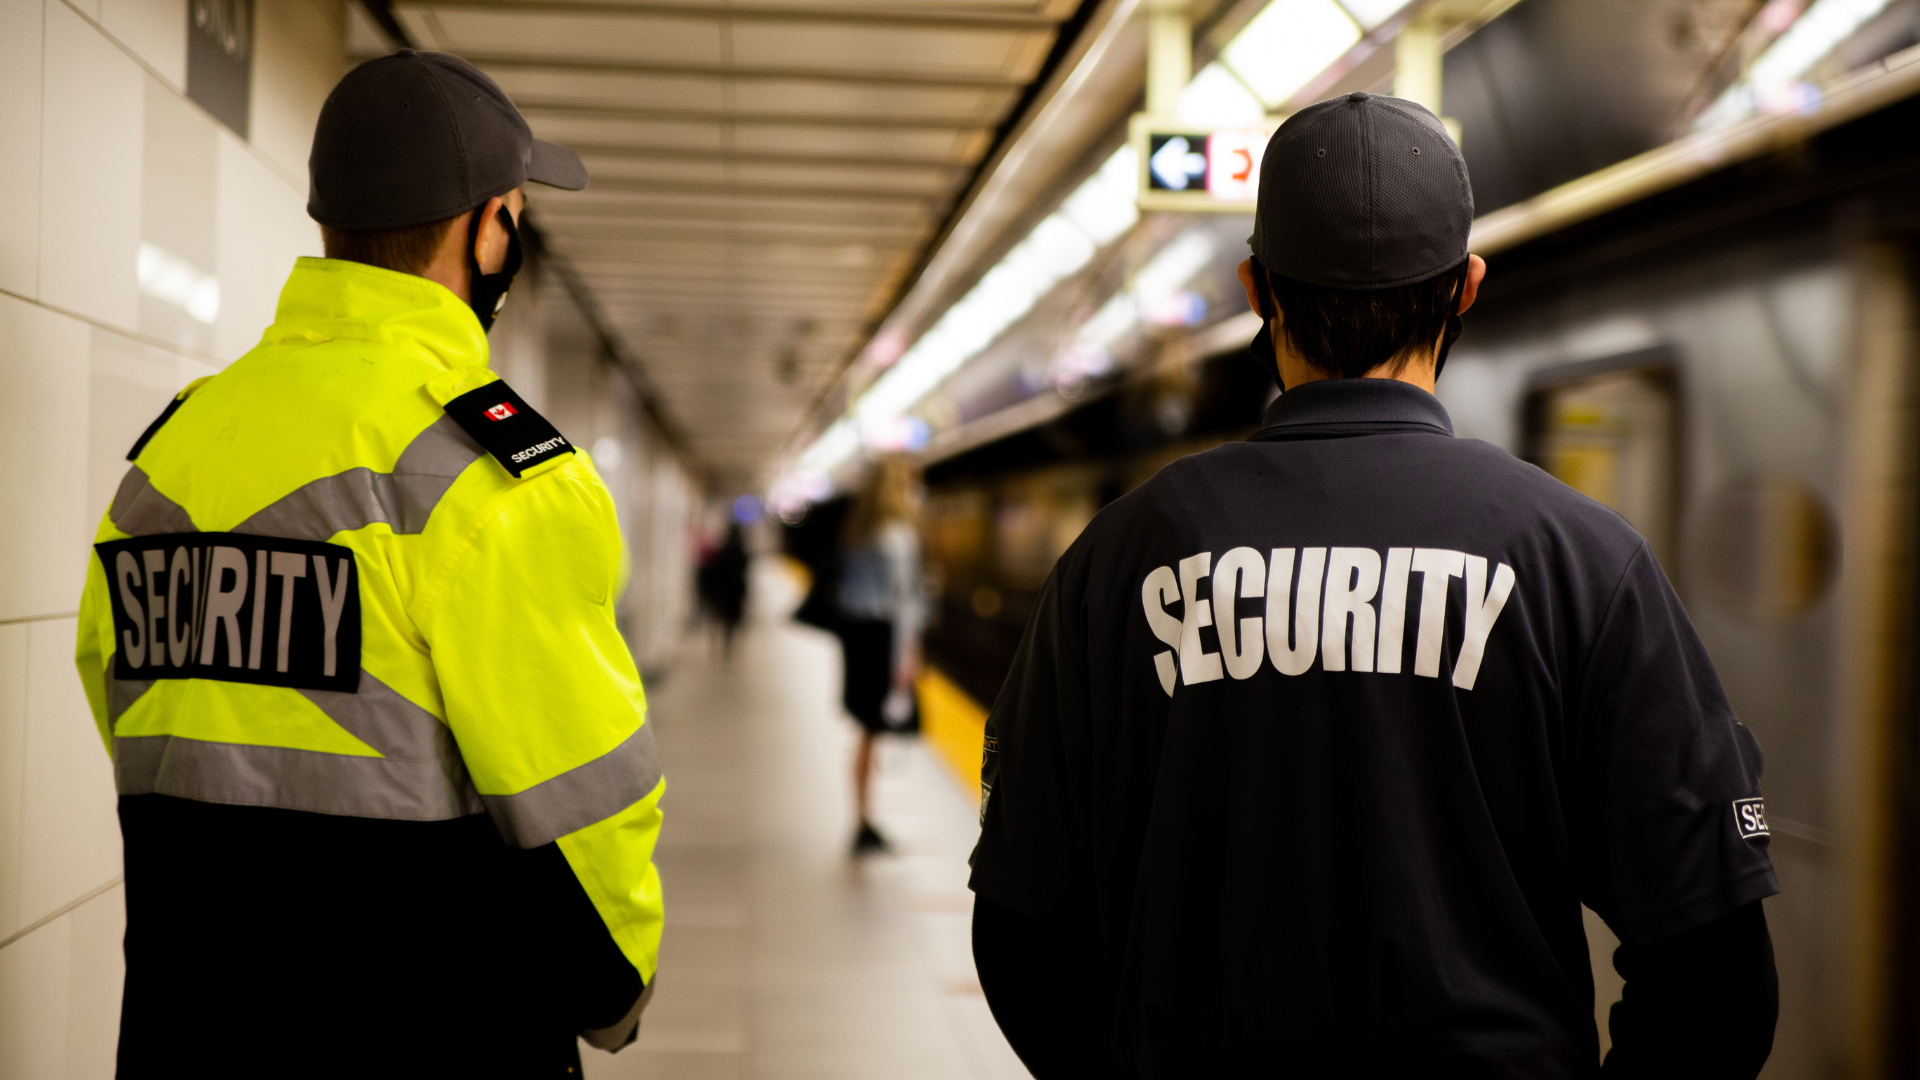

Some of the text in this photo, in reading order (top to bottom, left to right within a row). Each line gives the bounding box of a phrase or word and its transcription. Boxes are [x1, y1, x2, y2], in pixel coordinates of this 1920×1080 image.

[511, 436, 566, 463] SECURITY
[116, 545, 349, 677] SECURITY
[1141, 546, 1516, 698] SECURITY
[1741, 804, 1769, 831] SE
